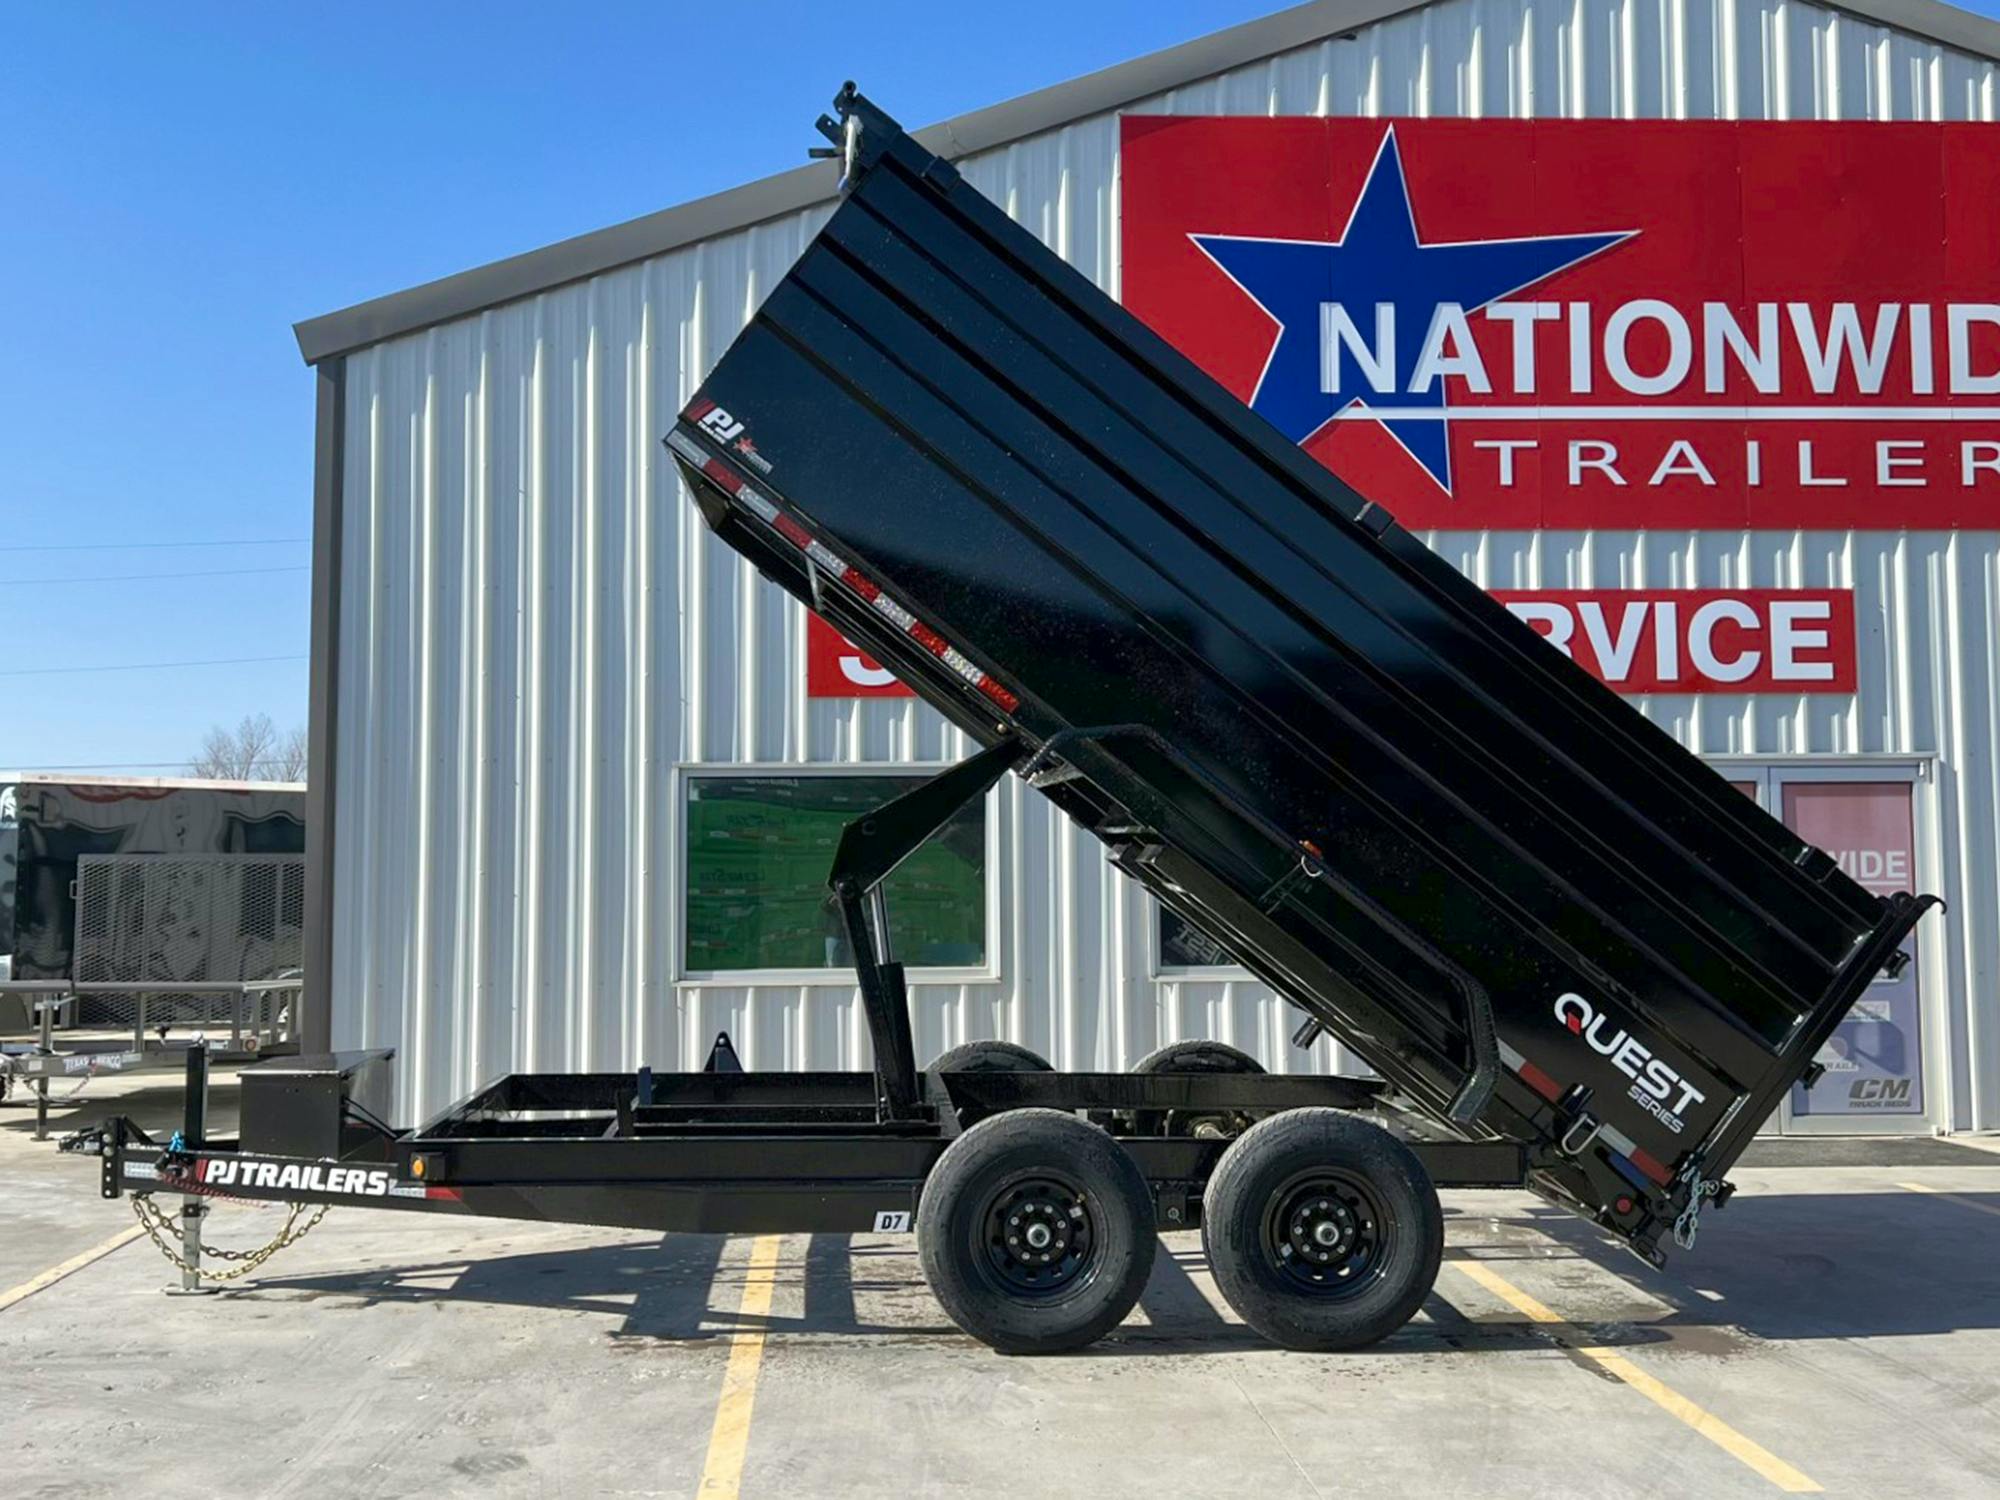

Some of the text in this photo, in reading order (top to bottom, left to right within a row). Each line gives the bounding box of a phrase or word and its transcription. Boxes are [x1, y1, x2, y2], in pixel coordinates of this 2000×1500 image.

[701, 407, 745, 440] PJ
[1554, 992, 1706, 1116] QUEST
[1848, 1079, 1911, 1100] CM
[1627, 1084, 1685, 1134] SERIES
[204, 1159, 389, 1196] PJ TRAILERS
[880, 1214, 903, 1230] D7
